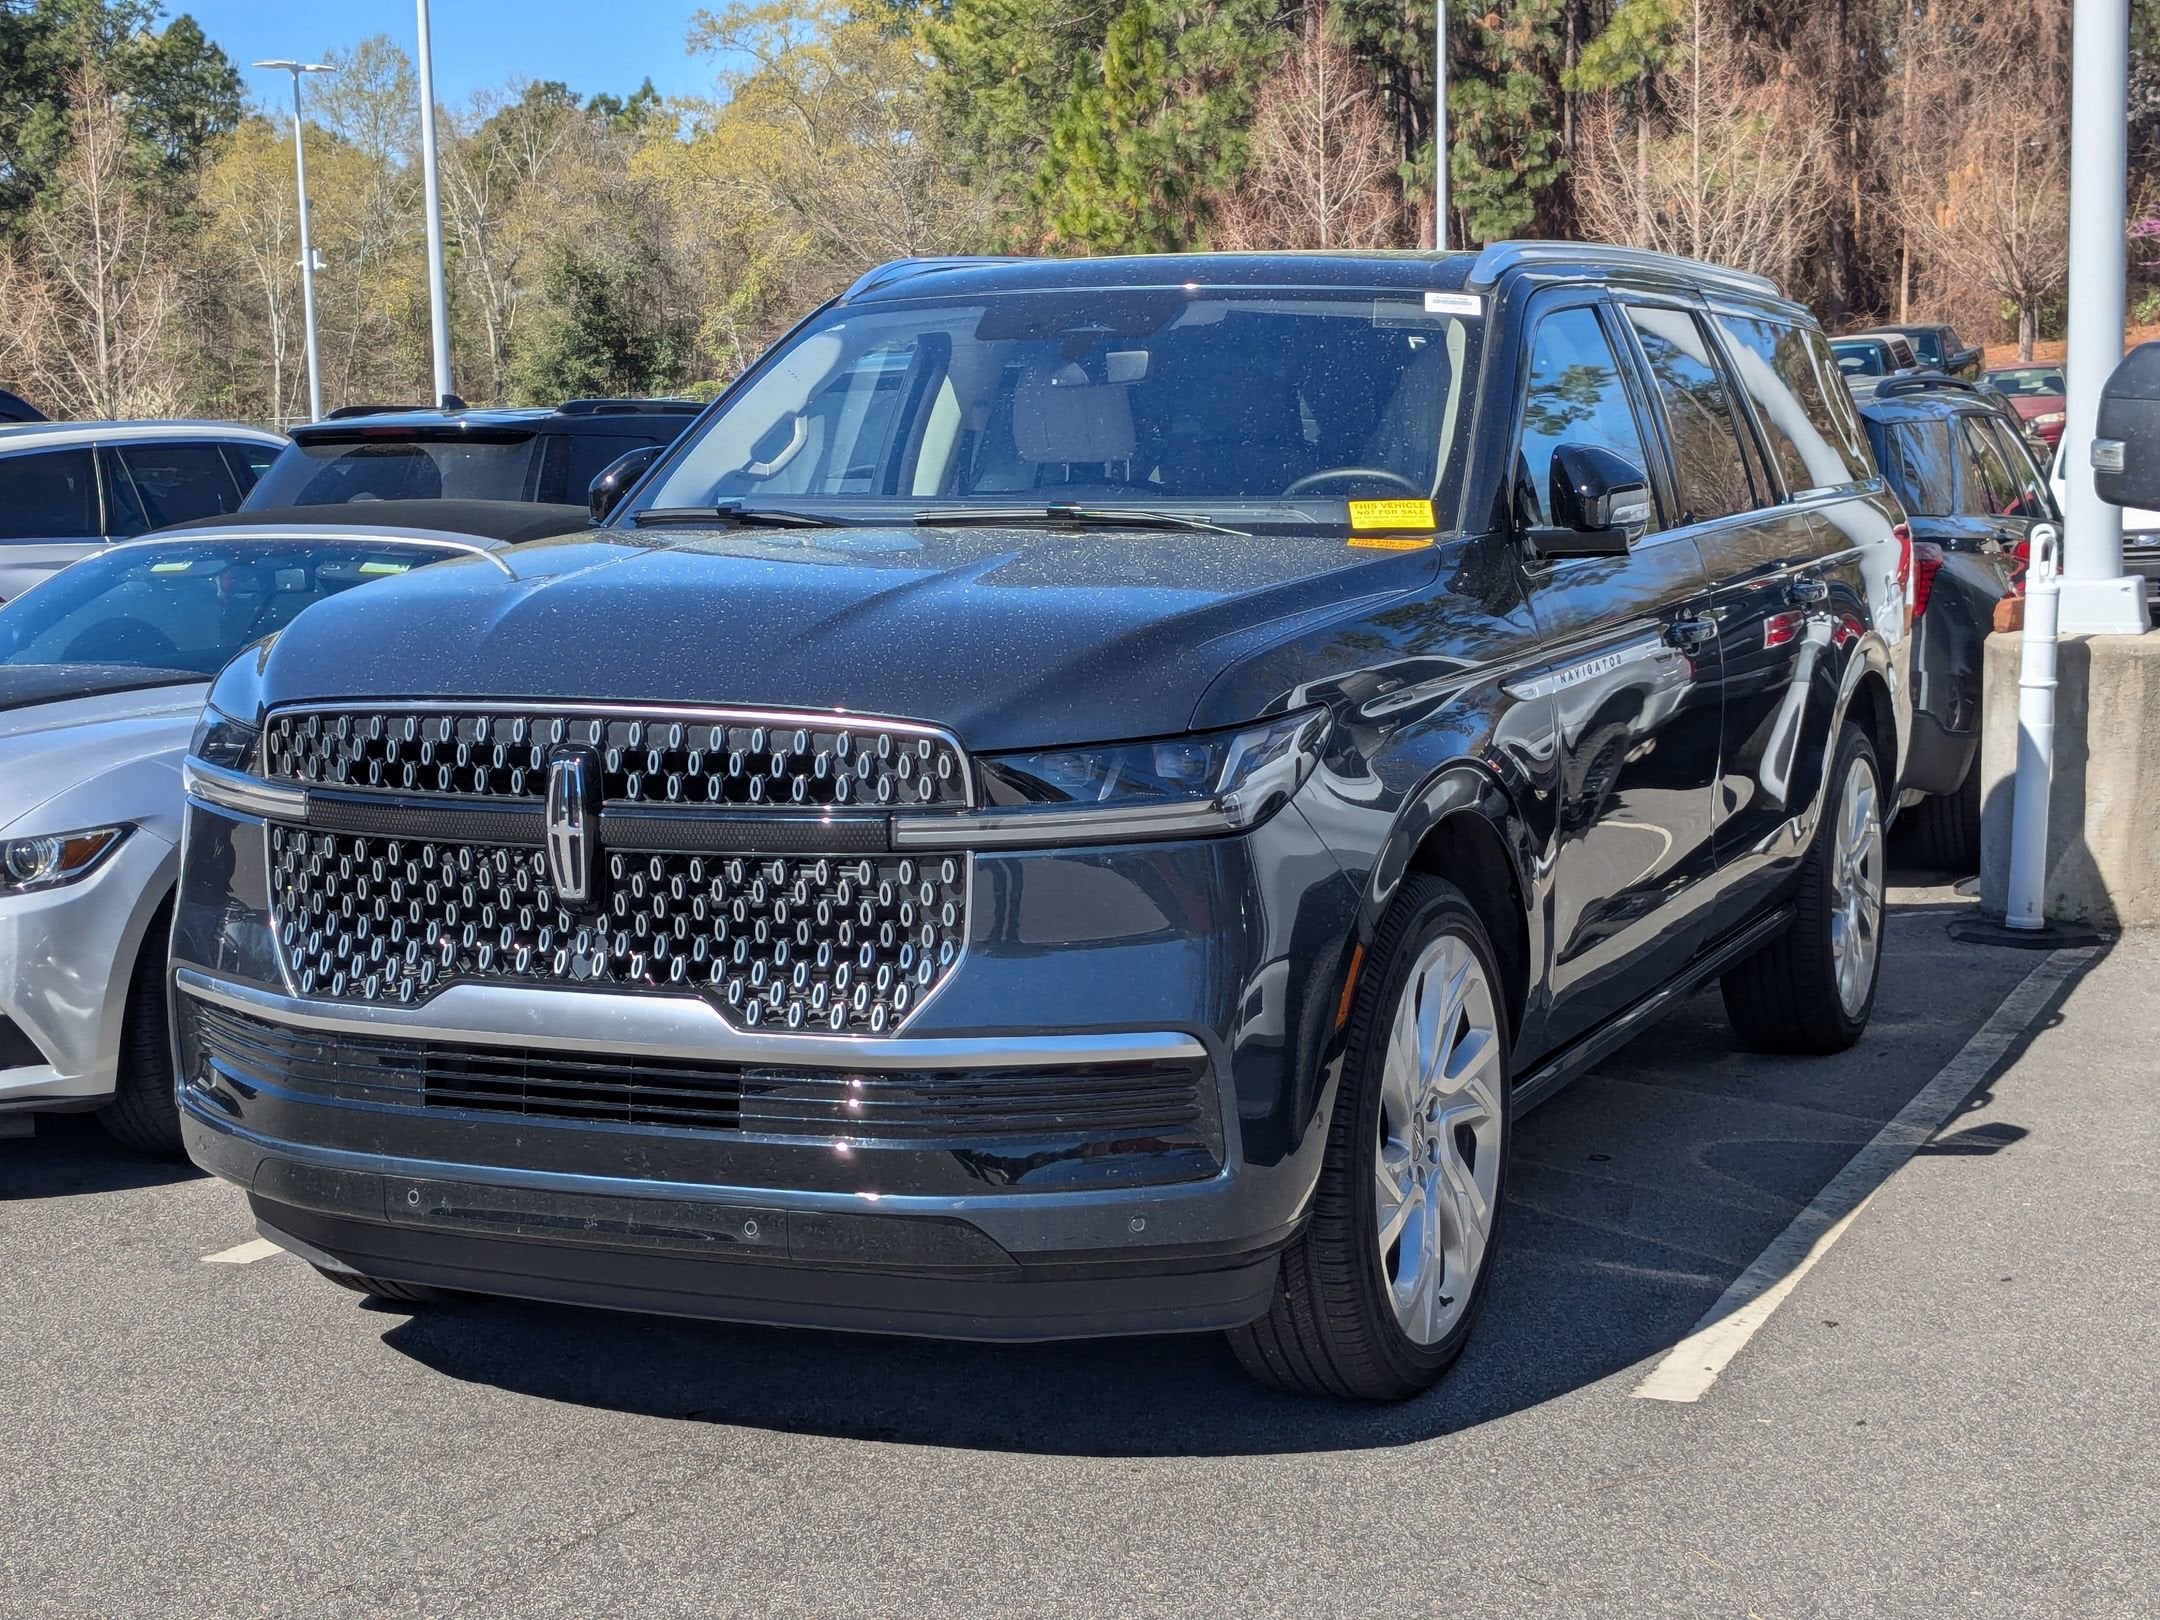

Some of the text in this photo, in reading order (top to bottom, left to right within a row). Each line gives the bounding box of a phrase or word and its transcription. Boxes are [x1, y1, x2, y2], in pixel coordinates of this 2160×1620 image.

[1354, 501, 1427, 510] THIS VEHICLE
[1560, 654, 1622, 684] NAVIGATOR
